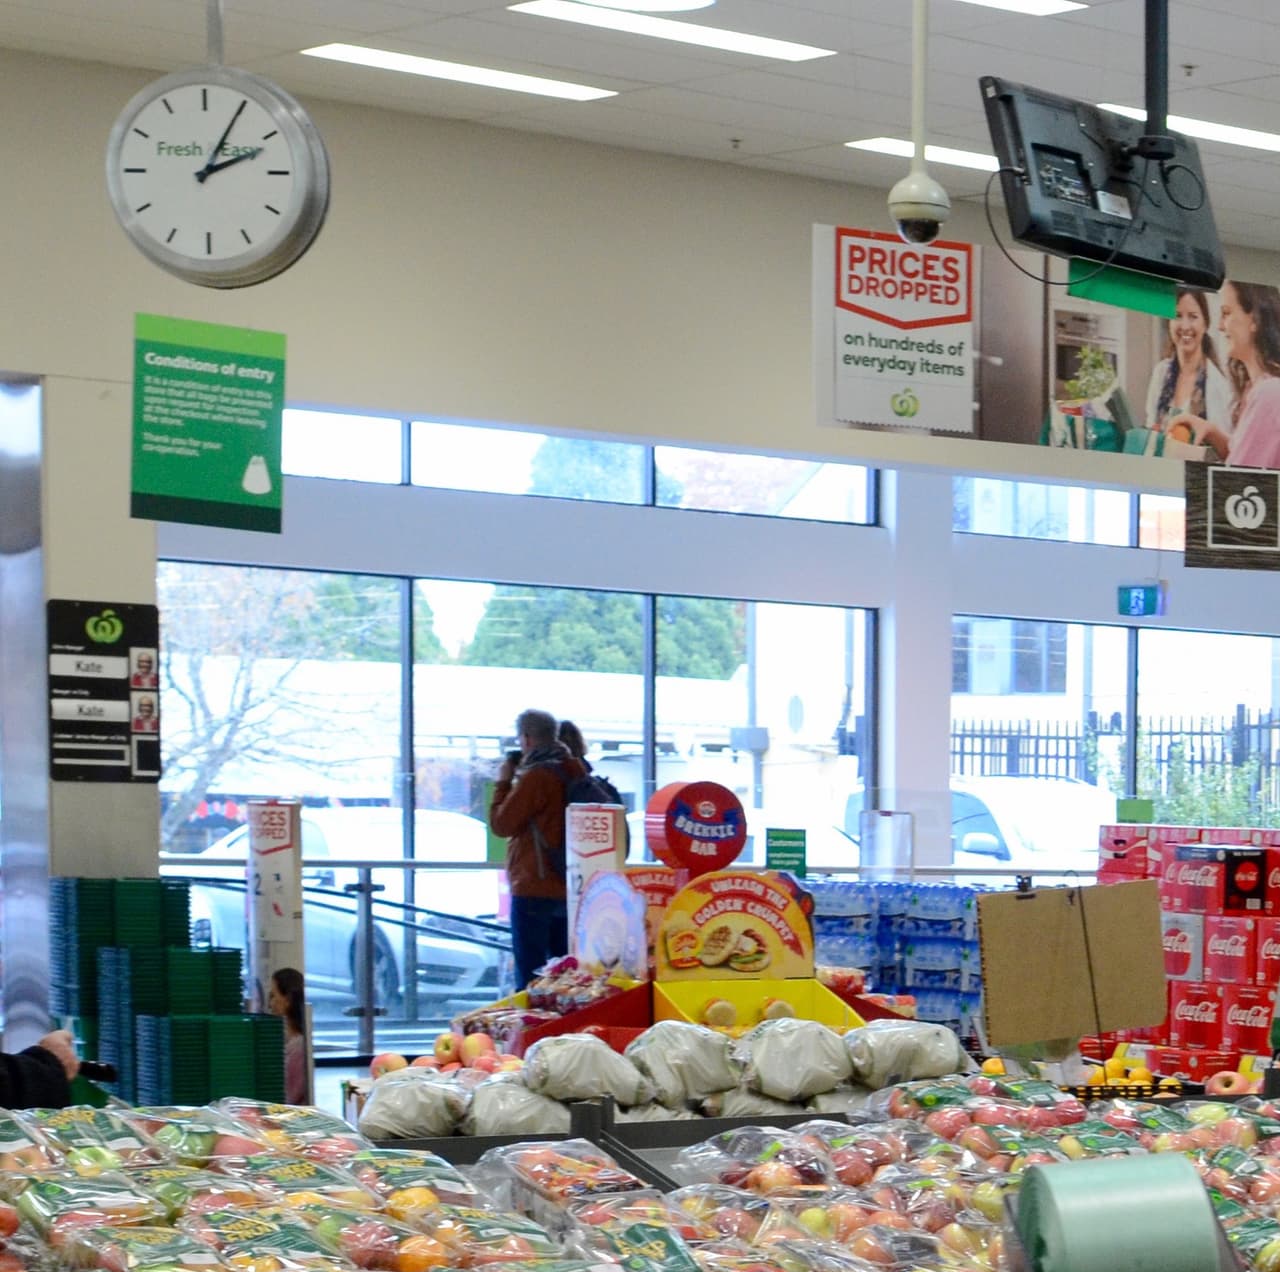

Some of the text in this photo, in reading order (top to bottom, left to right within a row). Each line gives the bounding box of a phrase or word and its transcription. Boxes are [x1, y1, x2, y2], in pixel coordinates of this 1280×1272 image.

[157, 141, 203, 156] Fresh
[848, 244, 960, 284] PRICES
[848, 274, 960, 306] DROPPED
[844, 332, 965, 356] on hundreds of
[144, 352, 276, 384] Conditions of entry
[843, 353, 965, 376] everyday items
[75, 660, 104, 673] Kate
[78, 704, 104, 717] Kate
[675, 815, 736, 838] BREKKIE
[690, 840, 718, 856] BAR
[1178, 864, 1219, 887] Coca-Cola
[710, 878, 790, 910] UNLEASH THE
[695, 899, 795, 942] GOLDEN CRUMPET
[1207, 934, 1248, 957] Coca-Cola
[1175, 999, 1219, 1023] Coca-Cola
[1227, 1003, 1271, 1028] Coca-Cola
